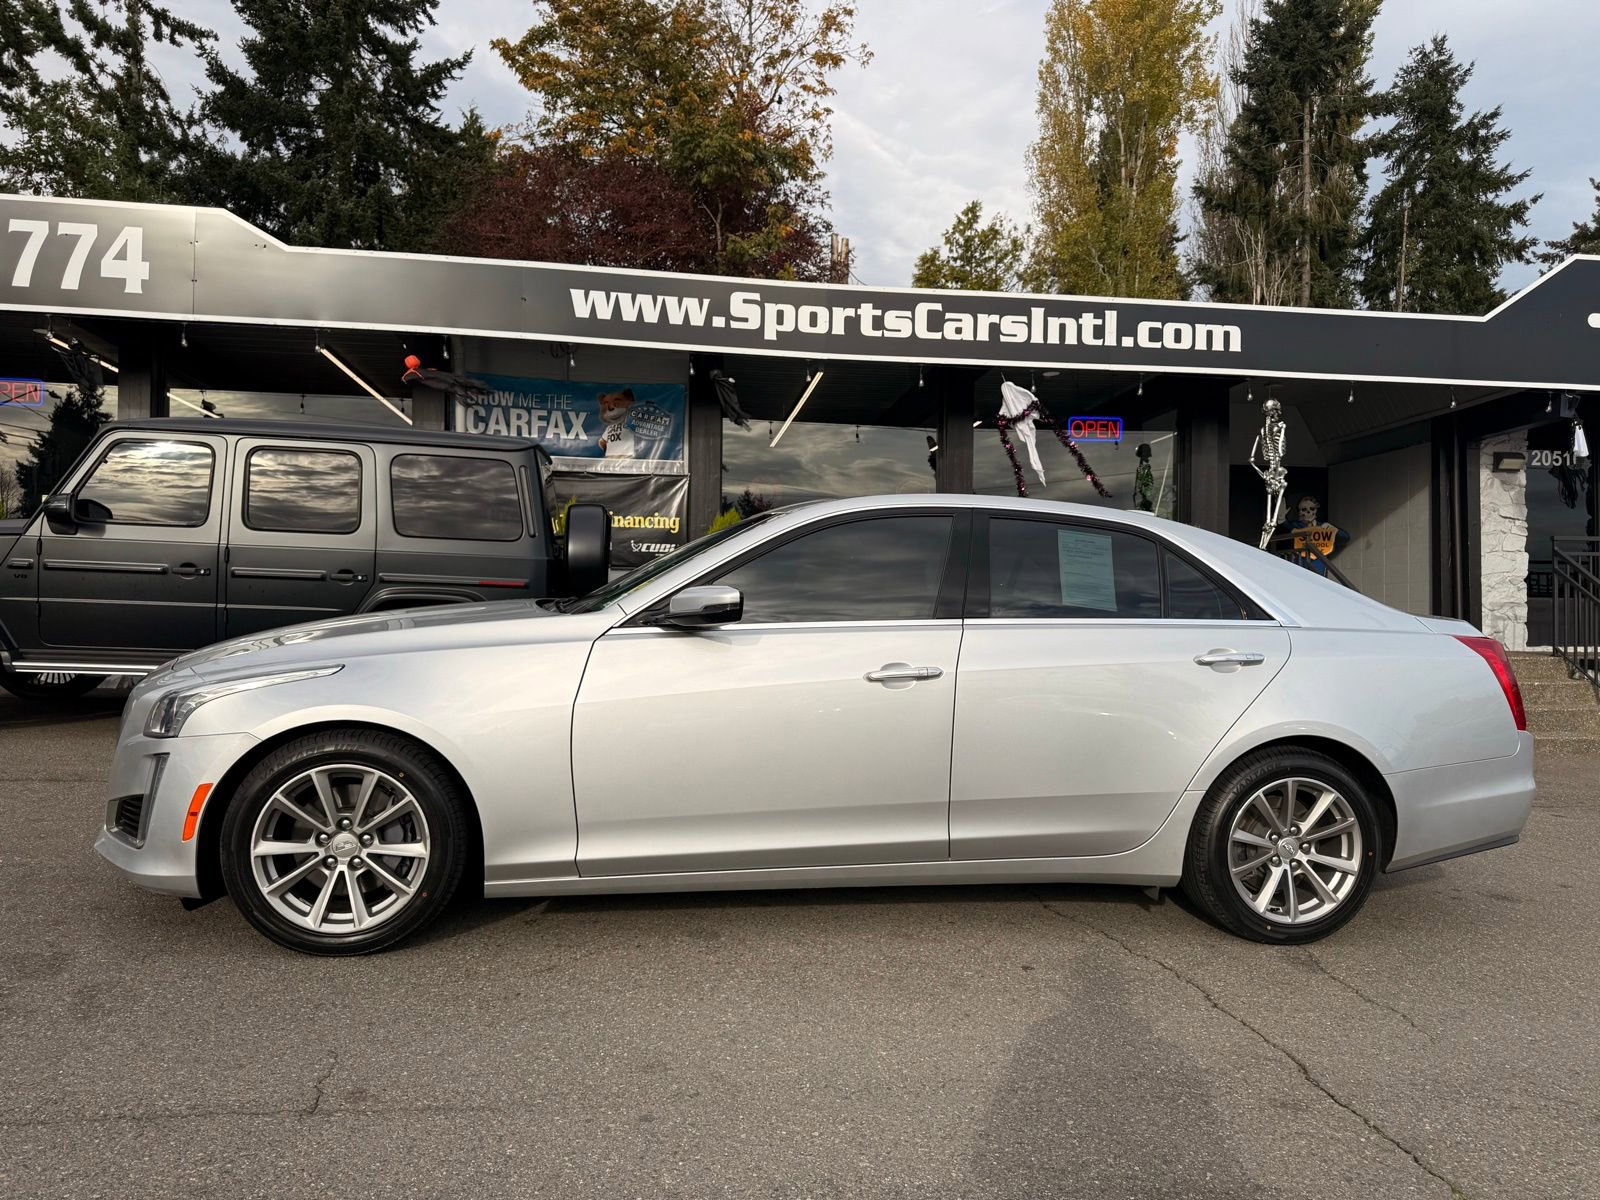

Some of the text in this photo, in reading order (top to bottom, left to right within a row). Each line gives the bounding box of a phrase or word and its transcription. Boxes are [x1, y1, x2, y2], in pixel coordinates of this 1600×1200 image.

[8, 218, 150, 294] 774
[569, 288, 1242, 352] www.SportsCarsIntl.com
[0, 381, 41, 403] PEN
[519, 393, 541, 408] ME
[546, 394, 573, 410] THE
[466, 404, 589, 440] CARFAX
[1071, 420, 1120, 438] OPEN
[609, 511, 680, 534] inancing
